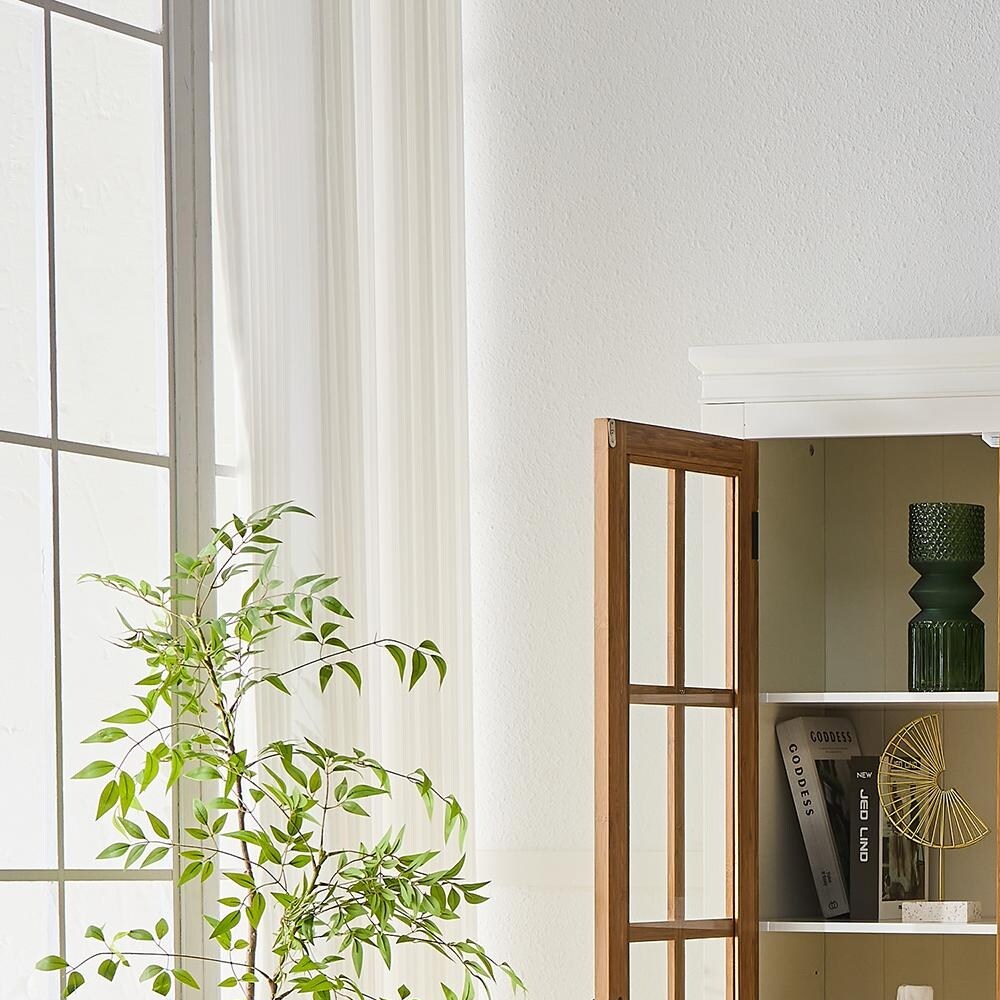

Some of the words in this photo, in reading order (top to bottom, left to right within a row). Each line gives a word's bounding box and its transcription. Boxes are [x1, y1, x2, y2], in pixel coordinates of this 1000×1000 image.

[810, 731, 852, 743] GODDESS
[788, 743, 814, 816] GODDESS
[859, 788, 869, 821] JED
[859, 827, 869, 862] LIND
